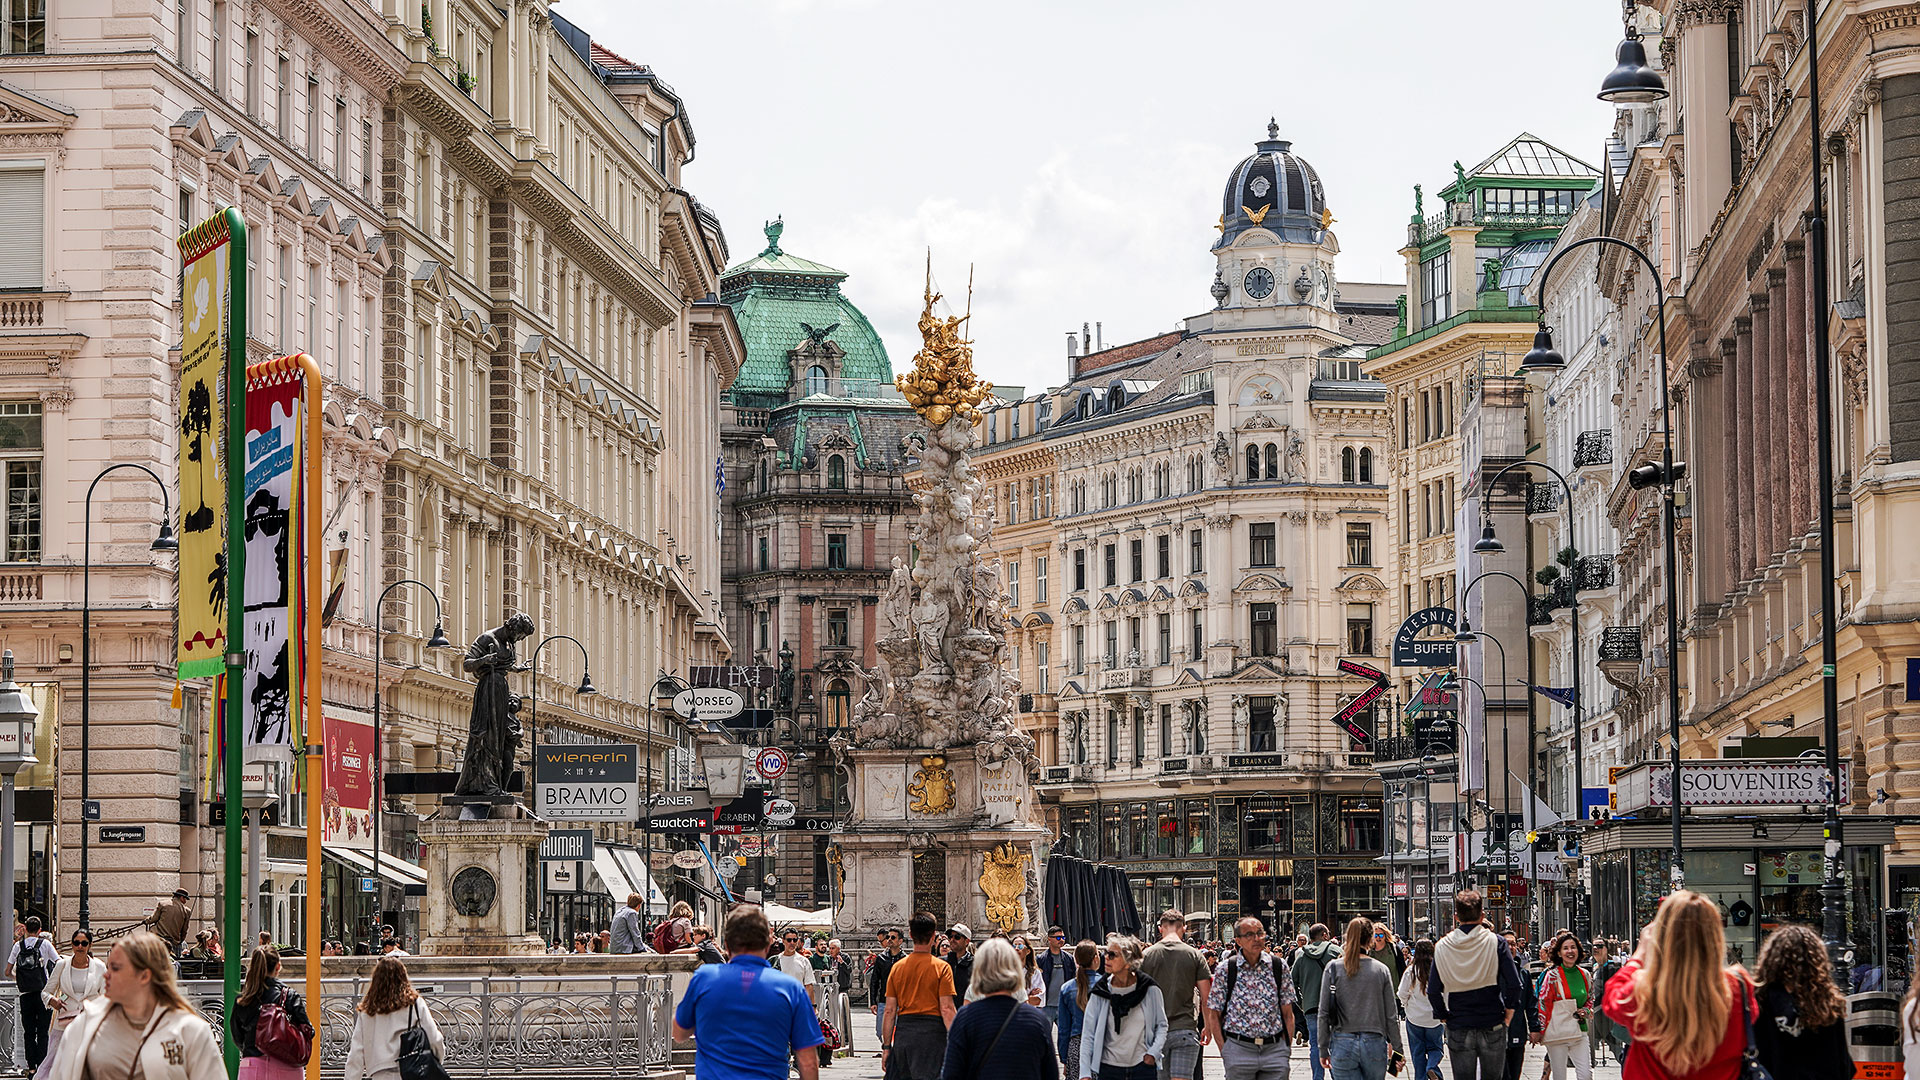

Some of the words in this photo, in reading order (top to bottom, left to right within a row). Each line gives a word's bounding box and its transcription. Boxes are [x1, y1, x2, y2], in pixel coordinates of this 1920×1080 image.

[1236, 343, 1286, 356] GENERALI
[683, 697, 733, 706] WORSEG
[1341, 686, 1383, 721] FLEDERMAUS
[546, 753, 628, 763] wienerin
[1682, 773, 1813, 791] SOUVENIRS
[546, 787, 627, 804] BRAMO
[215, 810, 270, 820] EAA
[721, 813, 755, 822] GRABEN
[650, 818, 698, 828] swatch
